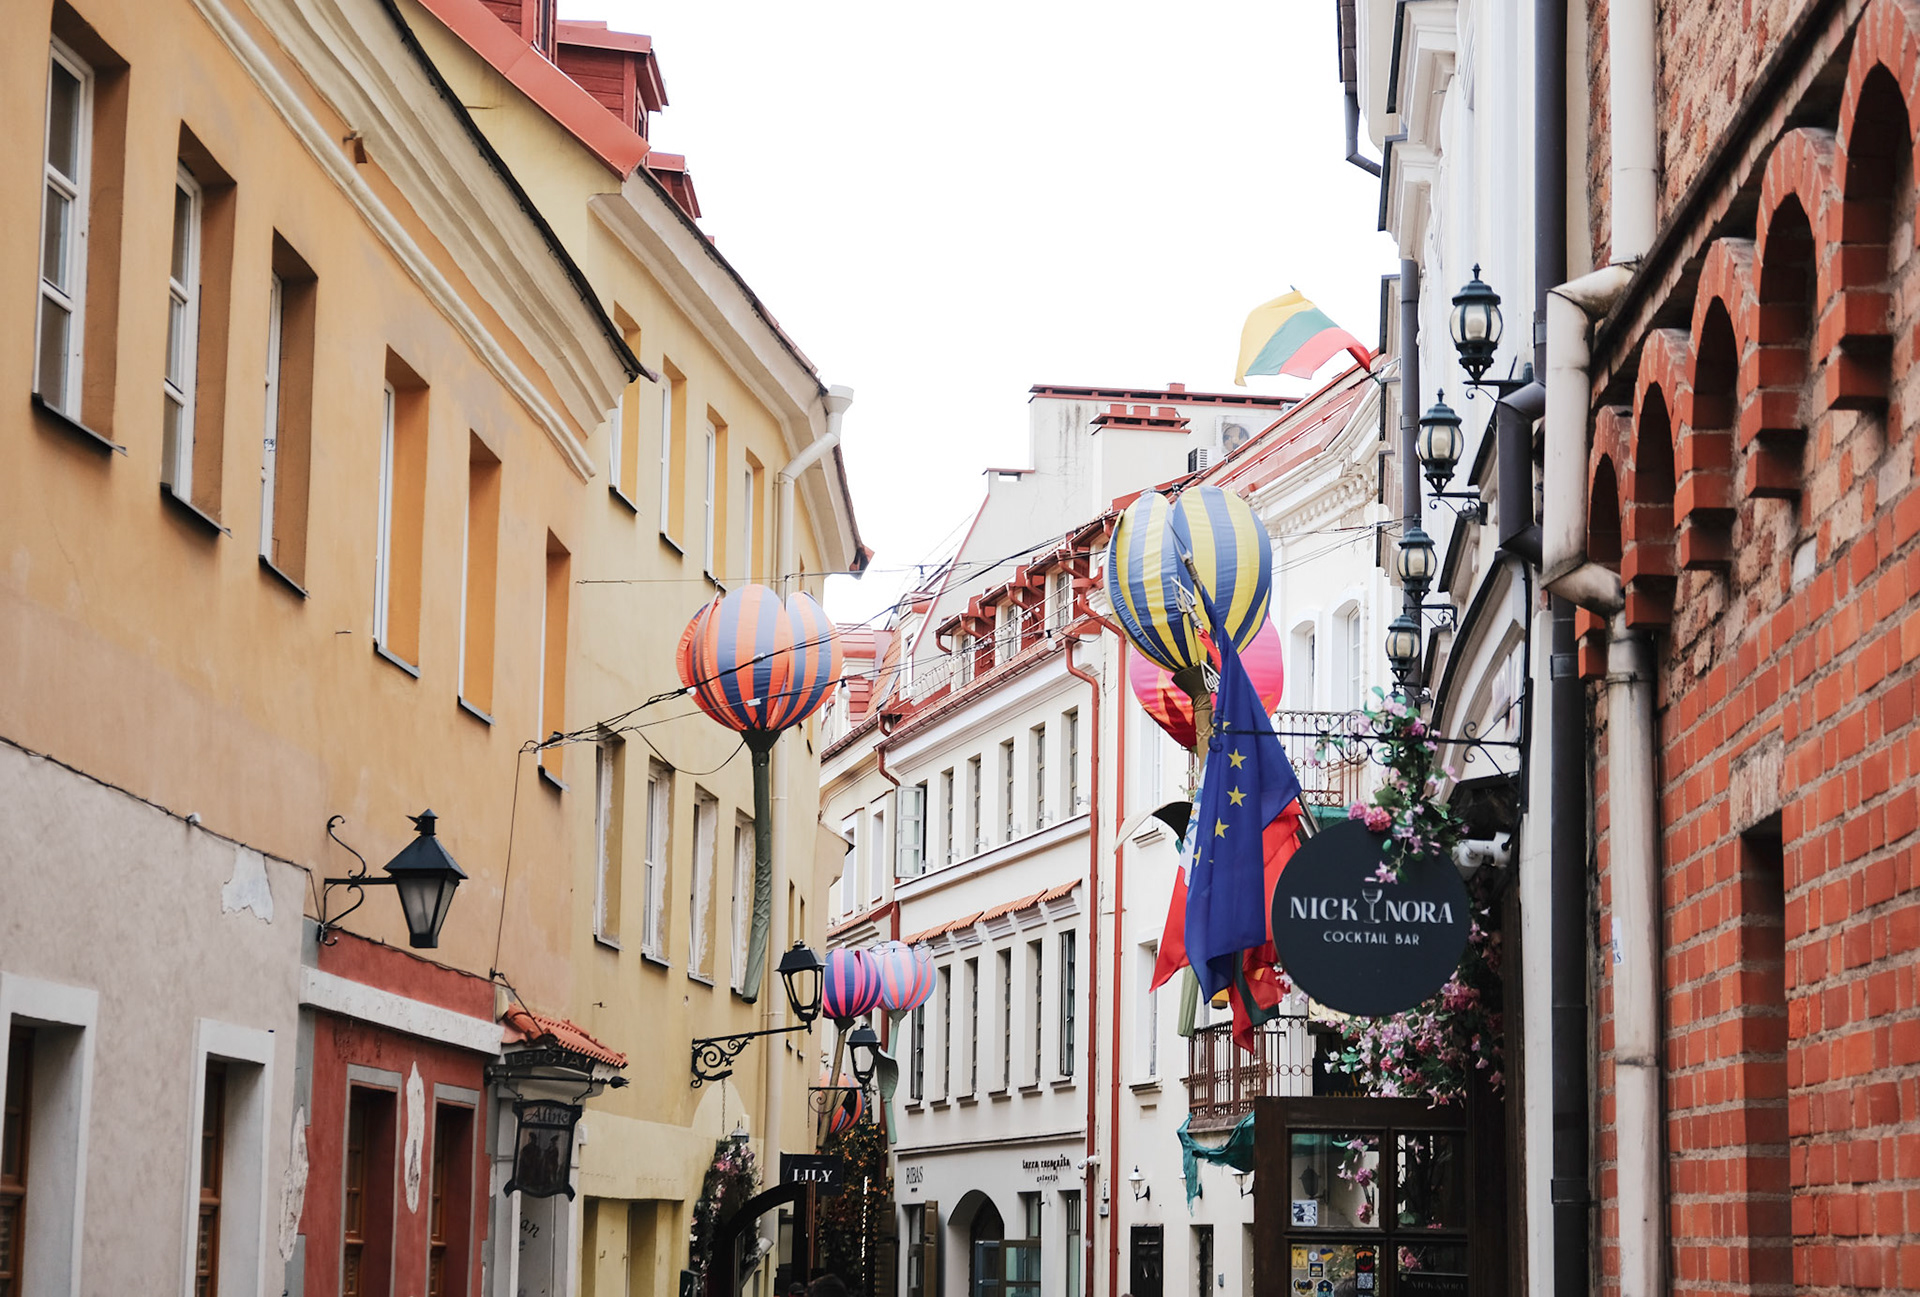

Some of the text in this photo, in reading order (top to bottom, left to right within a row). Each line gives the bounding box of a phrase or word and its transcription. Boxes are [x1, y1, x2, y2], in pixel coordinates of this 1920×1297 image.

[1290, 896, 1454, 924] NICK NORA
[1323, 931, 1420, 945] COCKTAIL BAR
[1022, 1159, 1039, 1169] terra
[792, 1168, 833, 1183] LILY
